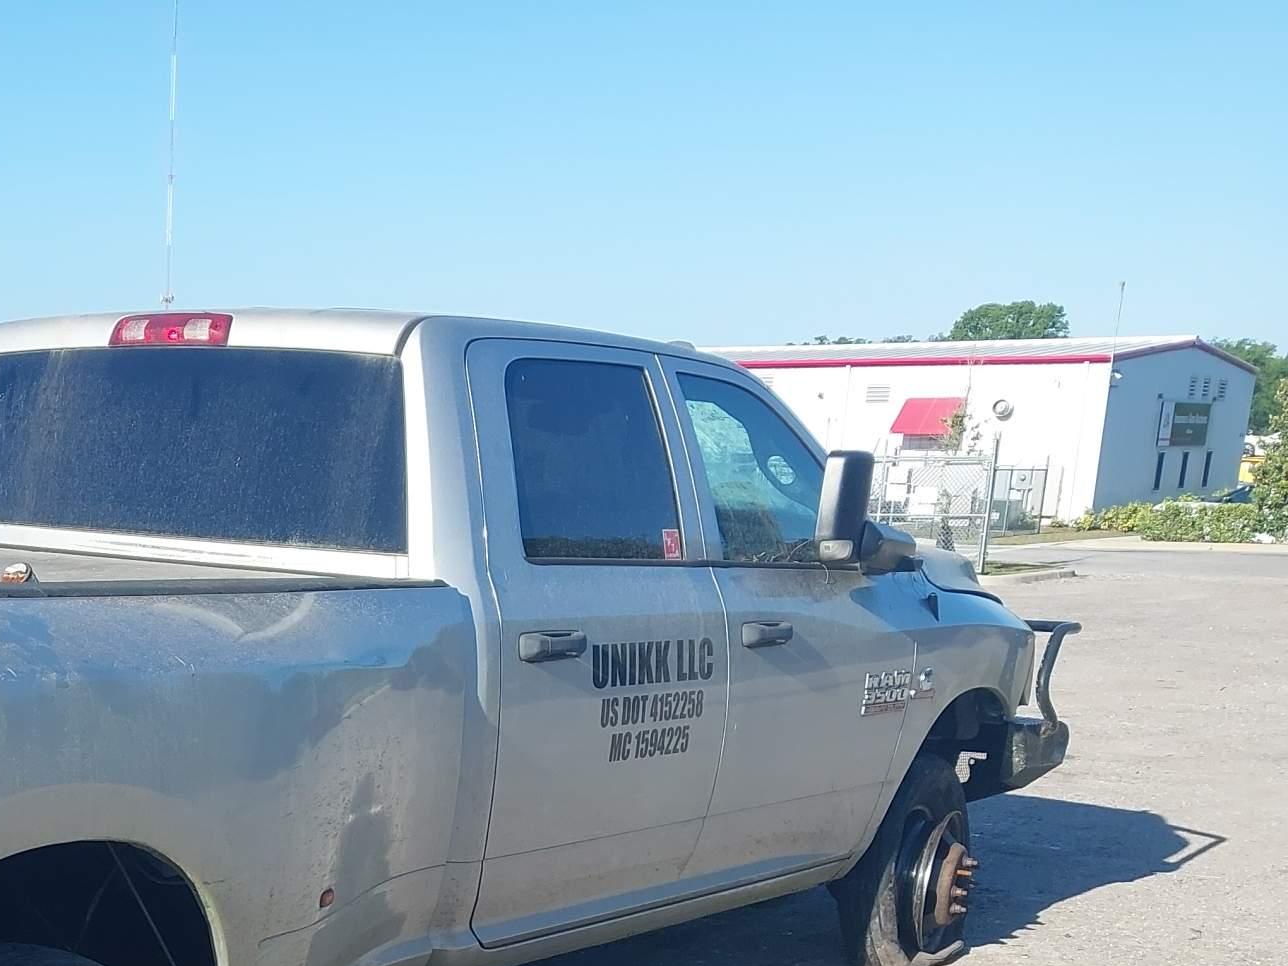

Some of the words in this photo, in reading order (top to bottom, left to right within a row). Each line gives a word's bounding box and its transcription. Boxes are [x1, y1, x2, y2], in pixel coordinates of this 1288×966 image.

[592, 639, 672, 689] UNIKK
[676, 637, 714, 681] LLC
[600, 697, 620, 728] US
[621, 694, 649, 726] DOT
[650, 690, 704, 722] 4152258
[609, 732, 631, 762] MC
[634, 726, 690, 759] 1594225
